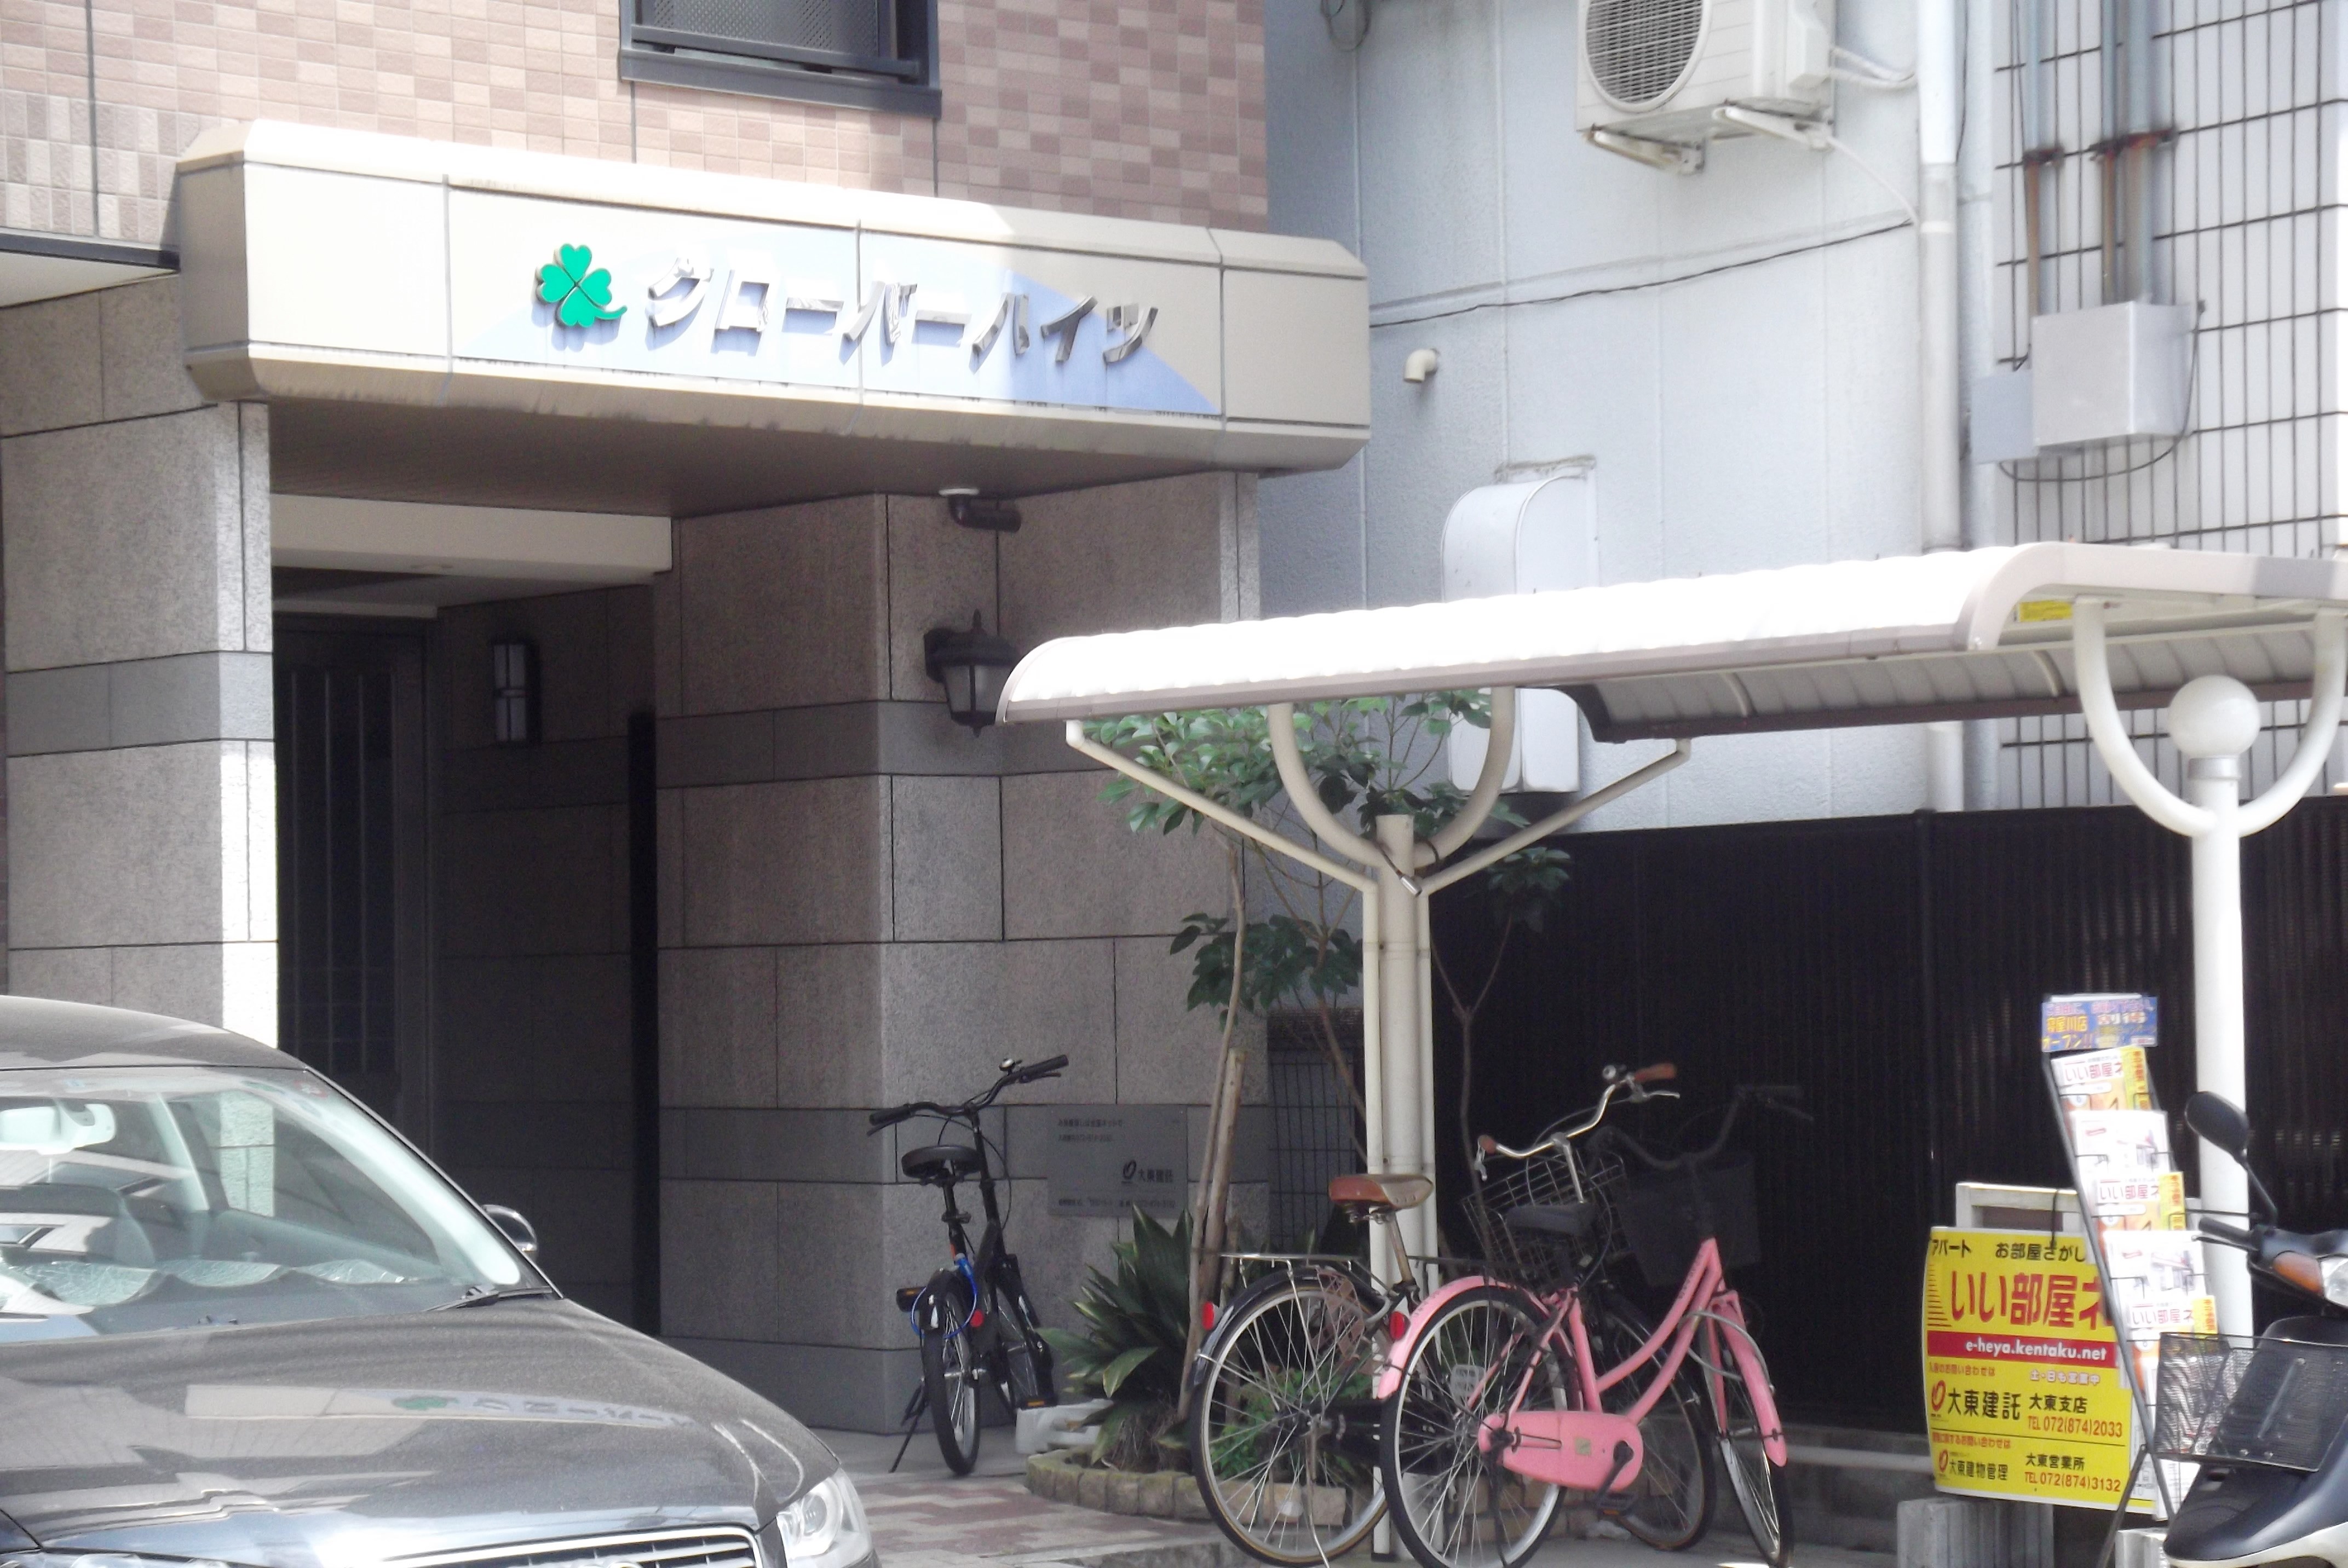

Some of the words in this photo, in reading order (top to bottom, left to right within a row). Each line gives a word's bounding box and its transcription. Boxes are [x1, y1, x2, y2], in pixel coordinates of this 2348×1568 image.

[647, 256, 1159, 364] クローバーハイツ
[1966, 1336, 2107, 1361] e-heya.kentaku.net
[1948, 1387, 2022, 1420] 大東建託
[2029, 1393, 2088, 1414] 大東支店
[2028, 1416, 2041, 1431] TEL
[2044, 1415, 2122, 1438] 072(874)2033
[2025, 1452, 2085, 1471] 大東営業所
[2024, 1471, 2038, 1484] TEL
[2040, 1471, 2121, 1492] 072(874)3132
